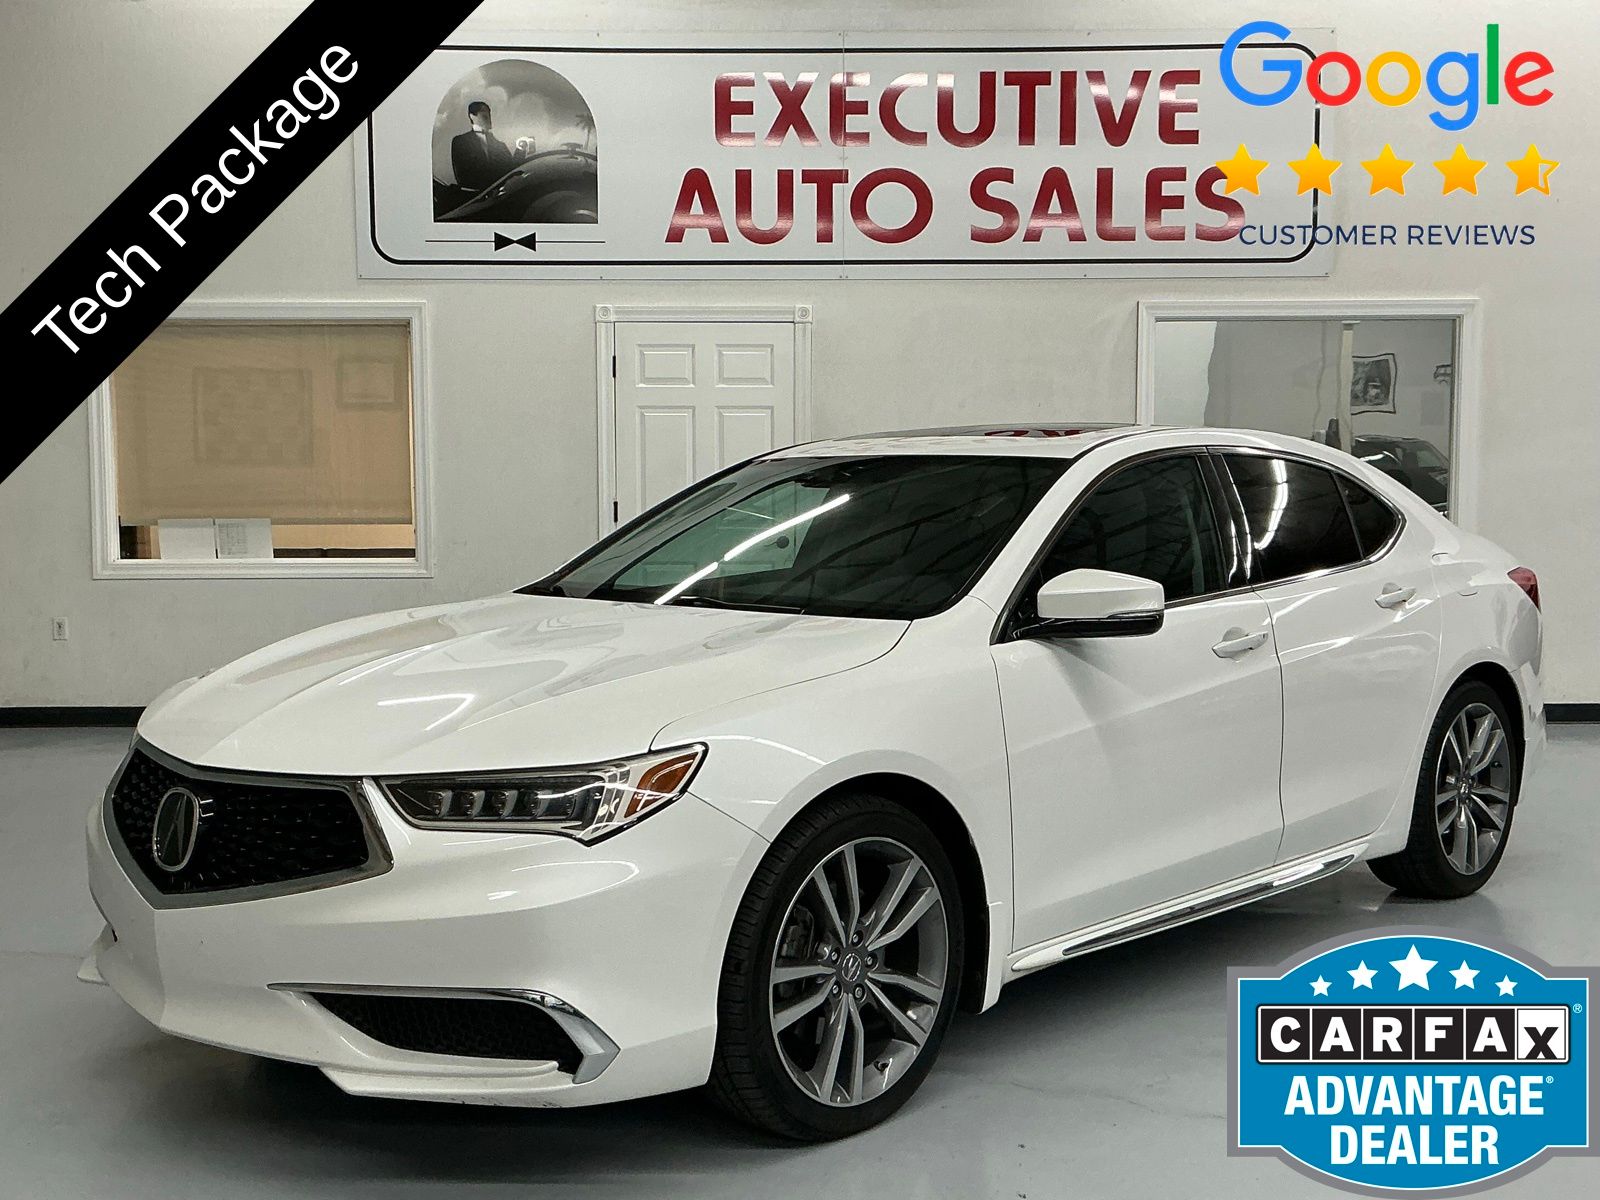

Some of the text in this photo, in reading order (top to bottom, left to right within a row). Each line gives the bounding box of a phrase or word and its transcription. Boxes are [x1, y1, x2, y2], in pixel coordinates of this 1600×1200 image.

[714, 70, 1201, 148] EXECUTIVE
[664, 166, 1246, 244] AUTO SALES
